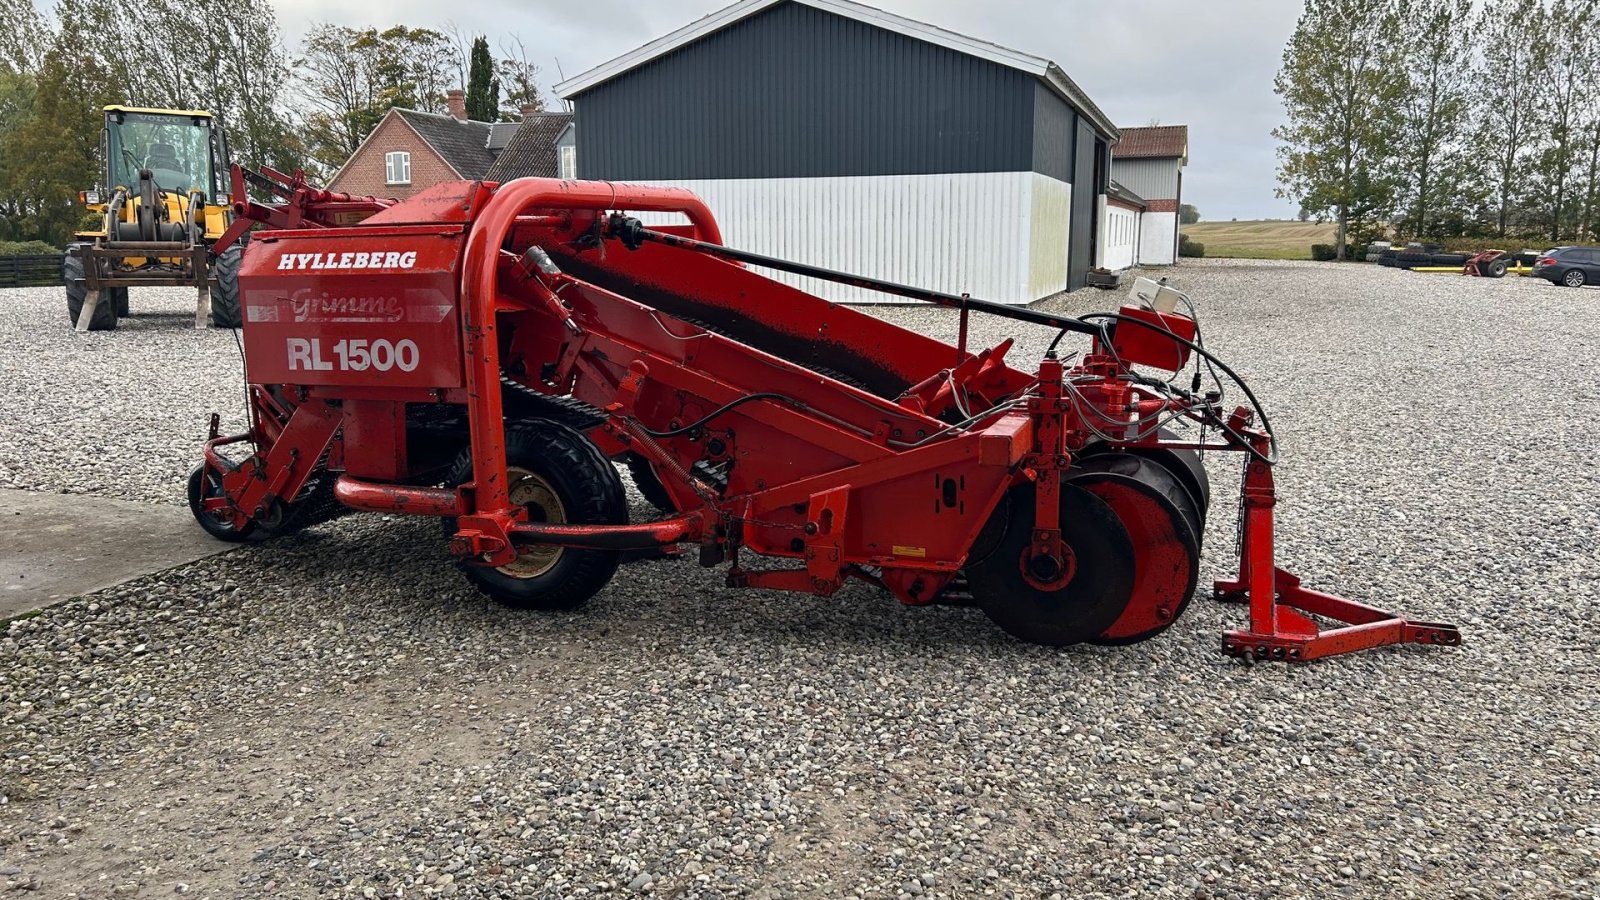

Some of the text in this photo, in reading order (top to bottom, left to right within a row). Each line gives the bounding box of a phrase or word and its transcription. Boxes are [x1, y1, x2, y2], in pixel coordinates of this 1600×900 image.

[137, 114, 180, 122] VOLVO
[277, 251, 417, 269] HYLLEBERG
[290, 288, 404, 322] Grimme
